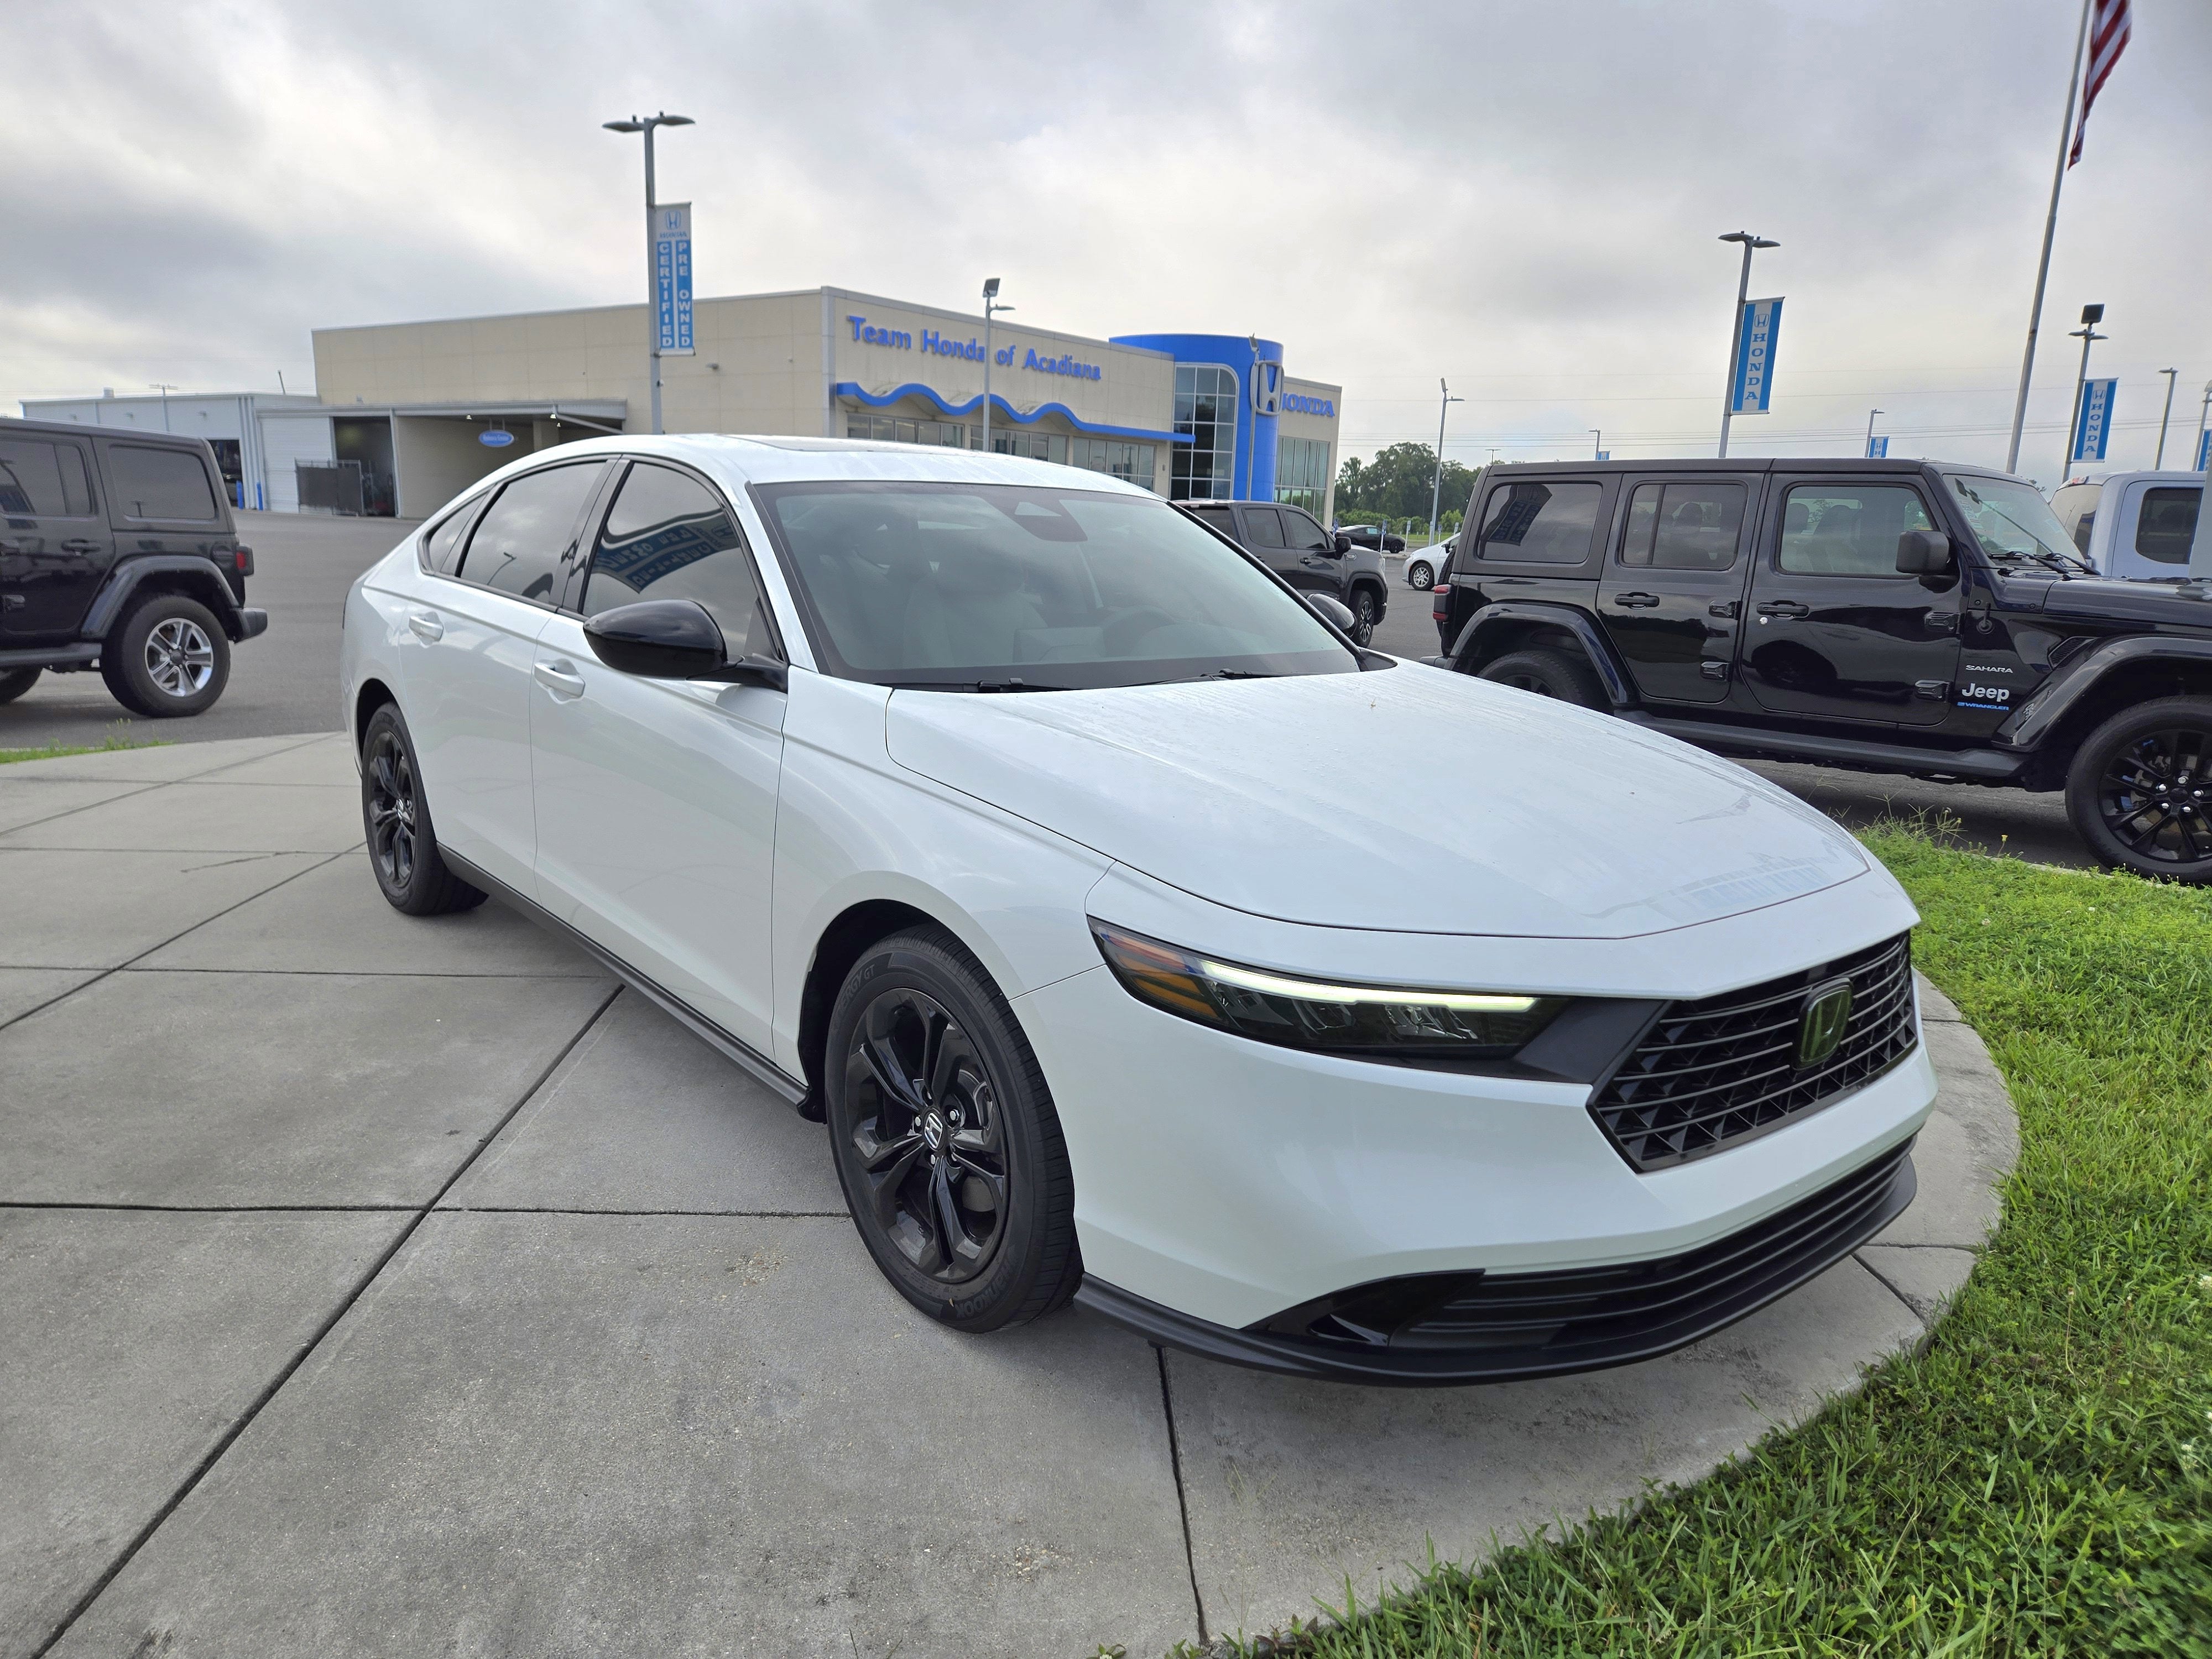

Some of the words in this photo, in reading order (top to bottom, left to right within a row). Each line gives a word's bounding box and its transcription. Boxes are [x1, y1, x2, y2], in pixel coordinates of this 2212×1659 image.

[678, 241, 688, 276] PRE
[659, 243, 672, 346] CERTIFIED
[678, 289, 691, 345] OWNED
[848, 315, 911, 349] Team
[922, 328, 985, 362] Honda
[996, 345, 1016, 367] of
[1024, 348, 1101, 380] Acadiana
[1745, 333, 1767, 400] HONDA
[2084, 403, 2103, 452] HONDA
[1961, 683, 2010, 702] Jeep
[1965, 665, 2013, 674] SAHARA
[1965, 702, 2009, 711] WRANGLER
